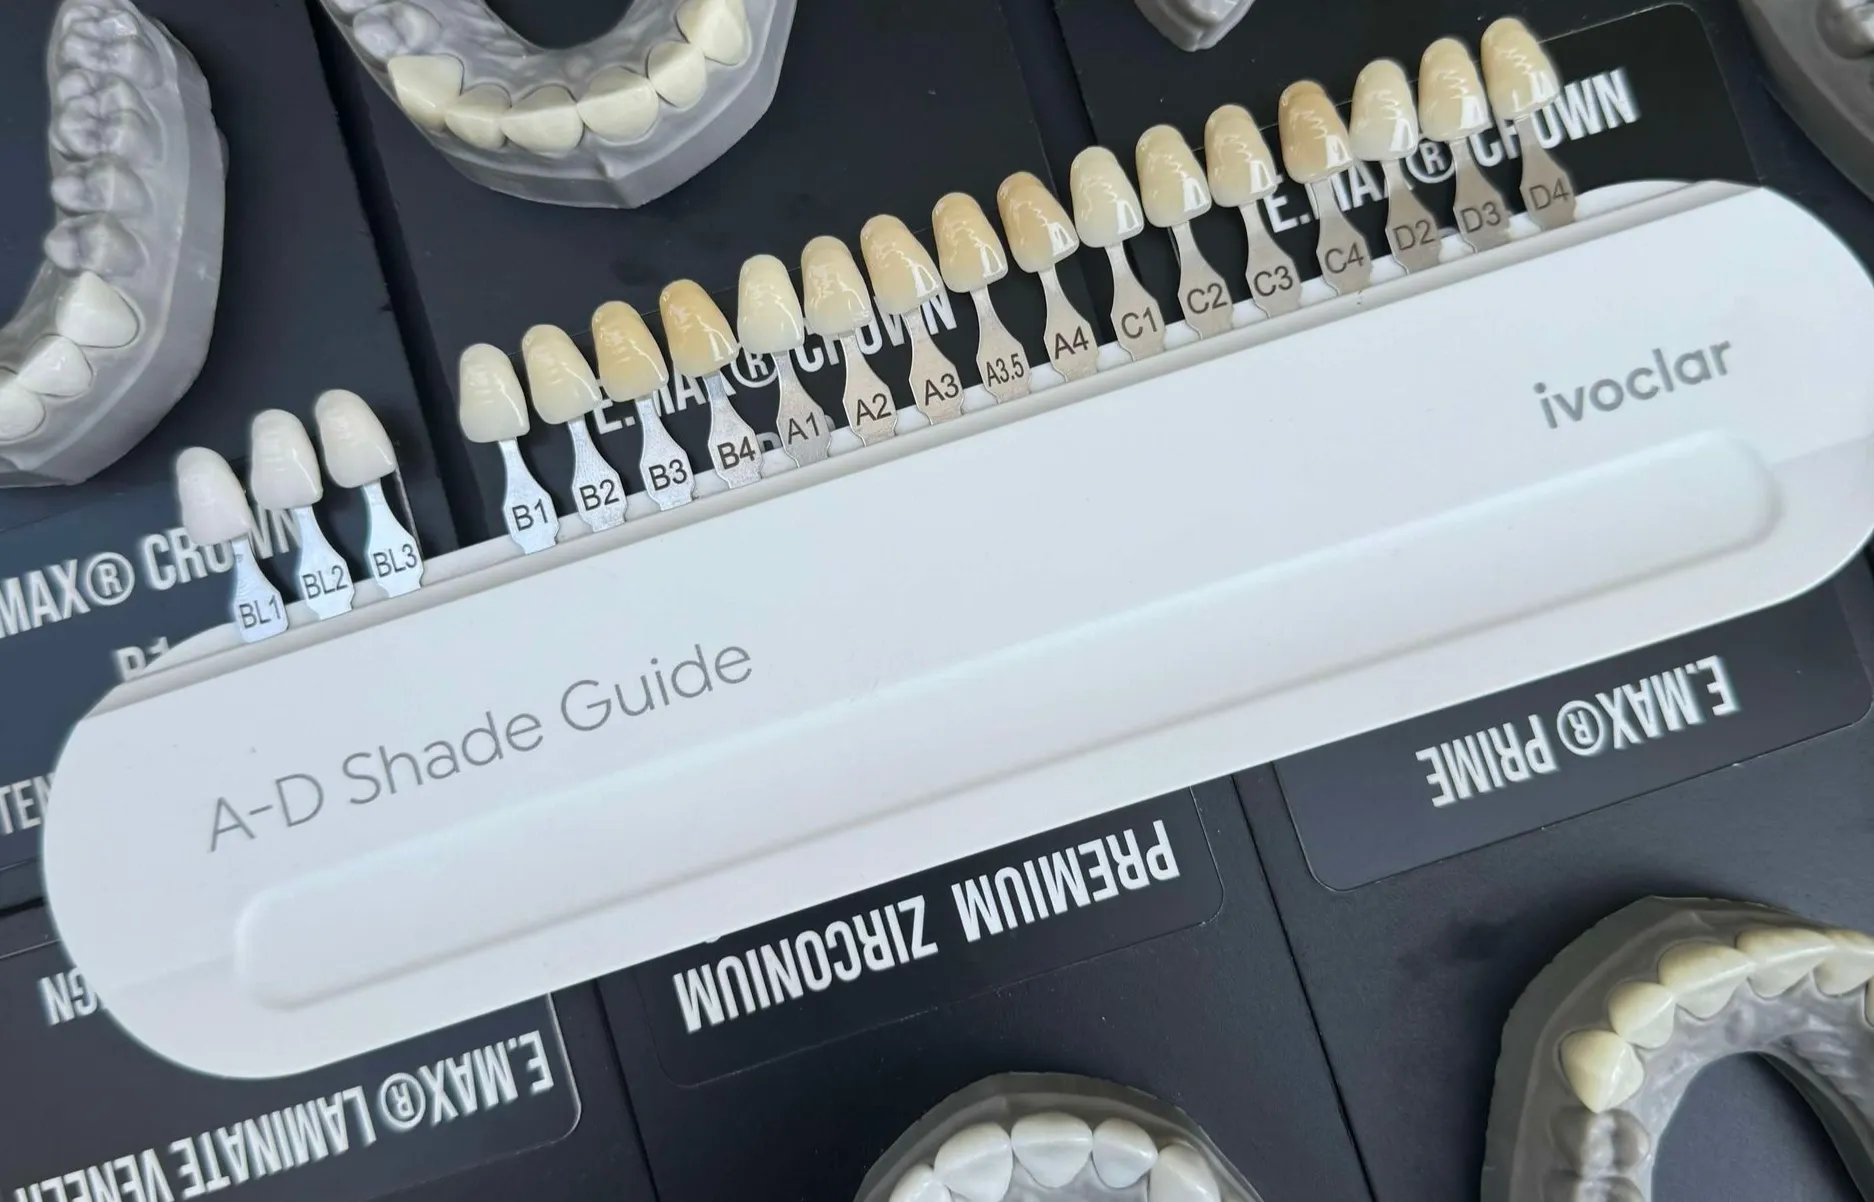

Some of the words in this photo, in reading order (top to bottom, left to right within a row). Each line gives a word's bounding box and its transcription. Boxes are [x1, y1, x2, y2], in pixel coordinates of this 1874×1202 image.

[1263, 133, 1456, 233] E.A®
[1529, 178, 1570, 210] D4
[1461, 202, 1501, 233] D3
[1393, 220, 1434, 250] D2
[1324, 243, 1364, 274] C4
[1254, 266, 1293, 296] C3
[1187, 283, 1228, 314] C2
[1121, 307, 1157, 339] C1
[1054, 327, 1089, 359] A4
[985, 354, 1025, 387] A3.5
[1533, 340, 1731, 429] ivoclar
[593, 348, 779, 434] E.A®
[924, 374, 959, 405] A3
[856, 393, 892, 425] A2
[788, 412, 819, 445] A1
[717, 436, 756, 470] B4
[649, 459, 688, 490] B3
[579, 479, 620, 511] B2
[512, 499, 550, 531] B1
[373, 544, 418, 577] BL3
[302, 566, 349, 600] BL2
[239, 595, 283, 629] BL1
[209, 772, 324, 852] A-D
[342, 711, 543, 804] Shade
[561, 644, 752, 731] Guide
[1416, 714, 1560, 808] PRIME
[951, 819, 1180, 942] PREMIUM
[673, 896, 938, 1034] ZIRCONIUM
[170, 1086, 377, 1200] LAMINATE
